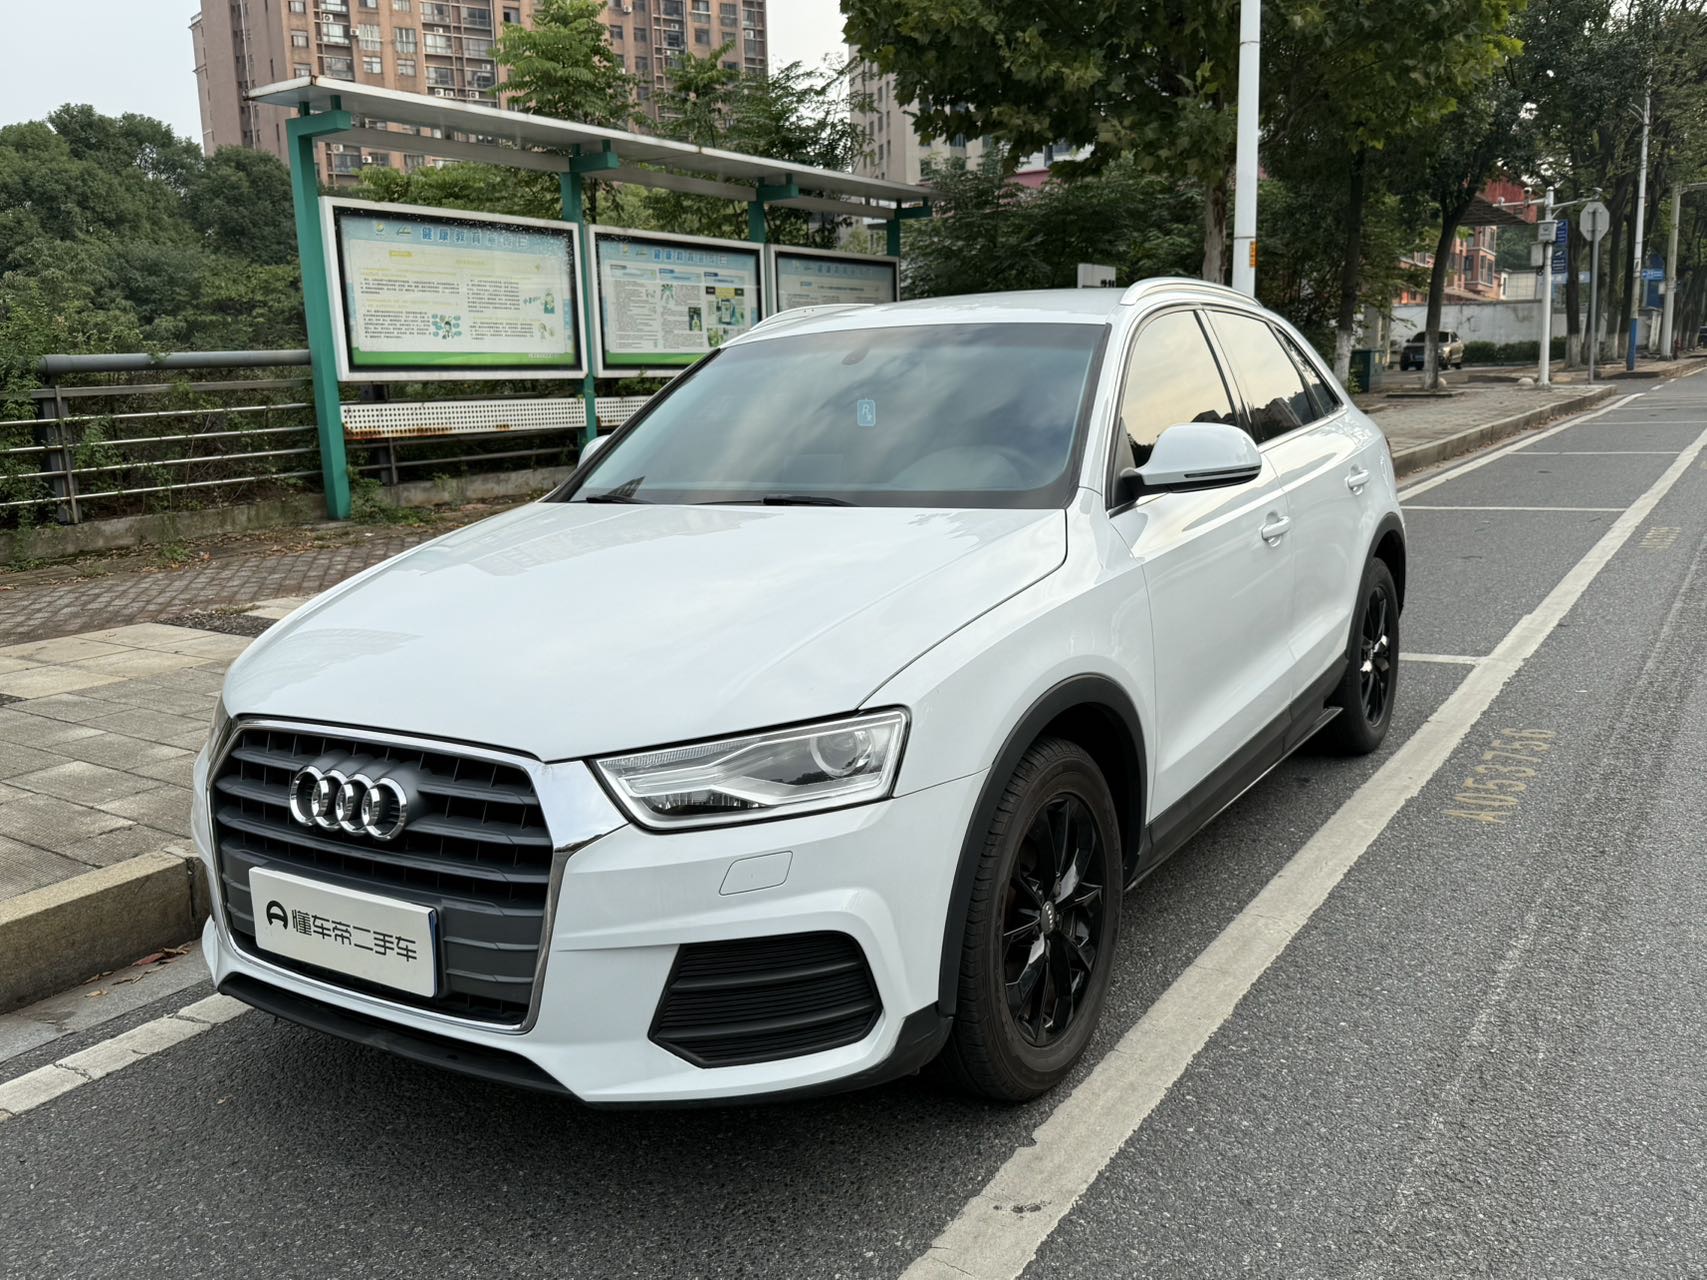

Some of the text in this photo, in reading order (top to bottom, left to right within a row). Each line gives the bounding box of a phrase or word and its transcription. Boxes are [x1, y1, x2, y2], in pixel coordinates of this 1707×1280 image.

[291, 908, 418, 963] 懂车帝二手车
